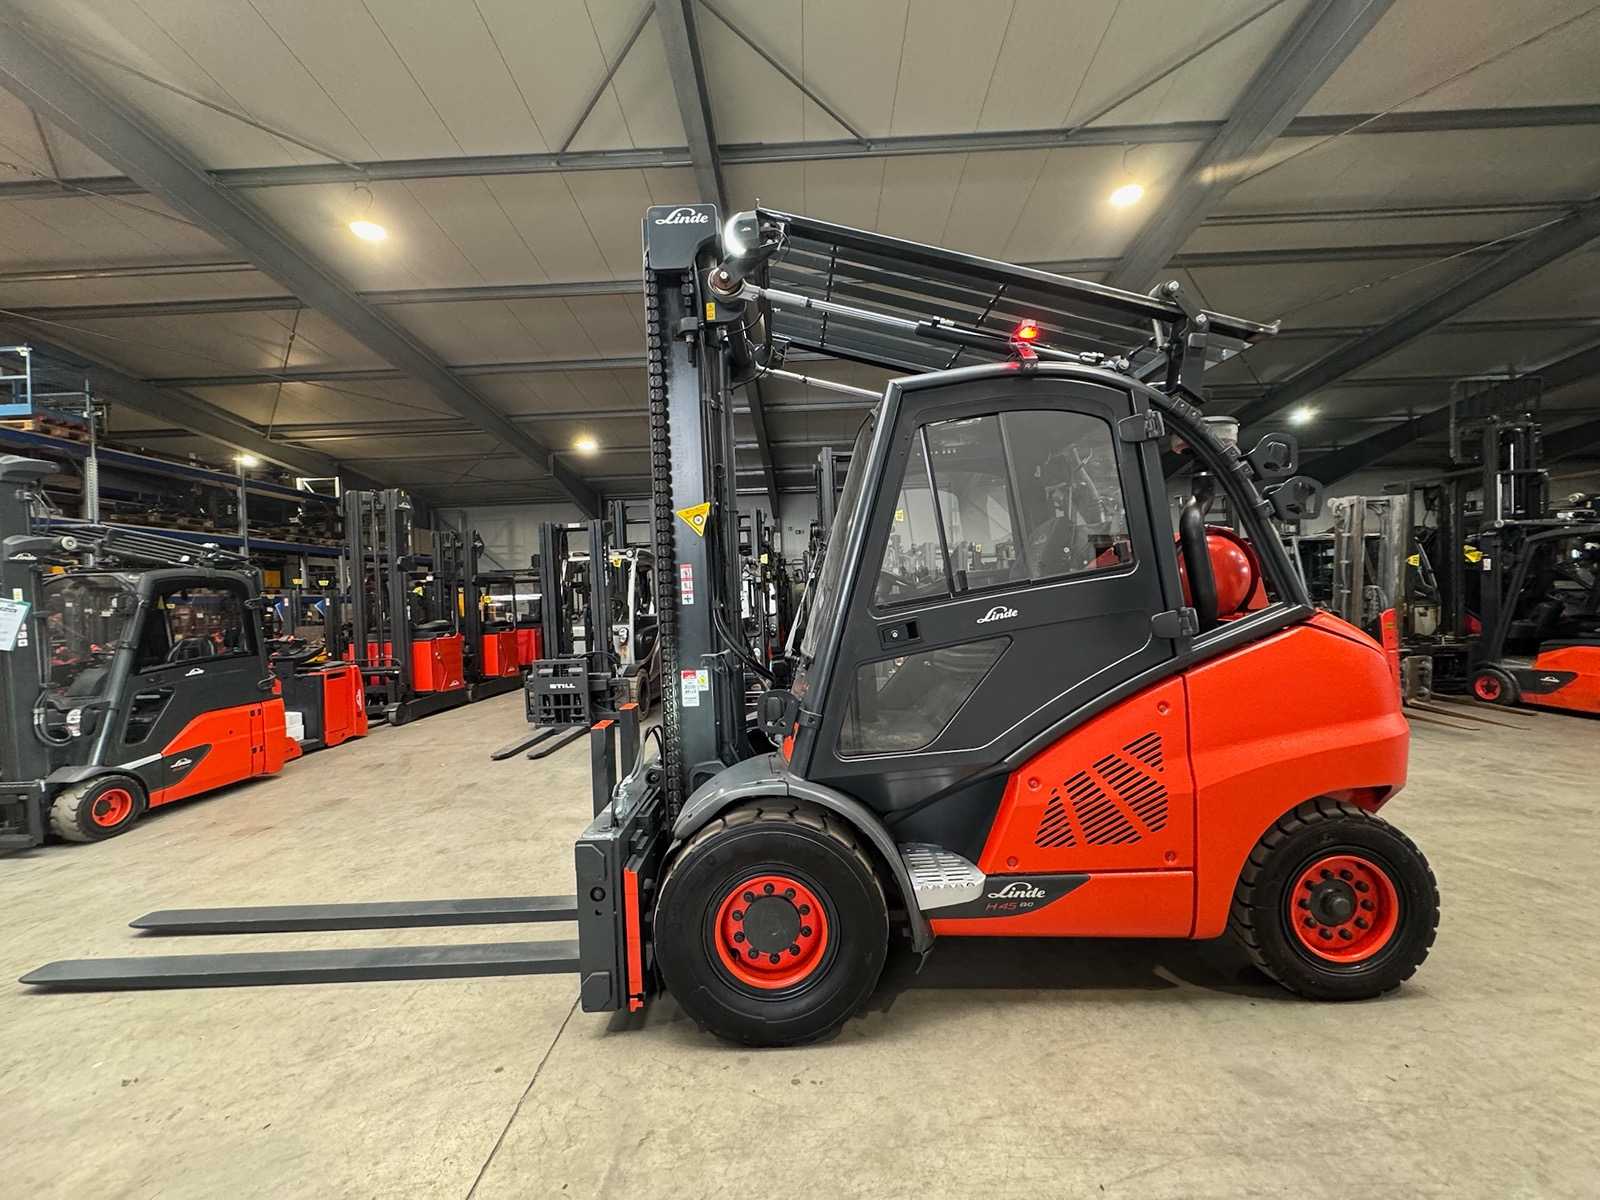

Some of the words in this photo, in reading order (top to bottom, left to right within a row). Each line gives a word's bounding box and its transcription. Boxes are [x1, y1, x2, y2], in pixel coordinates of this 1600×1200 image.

[655, 207, 709, 225] Linde
[976, 605, 1018, 624] Linde
[987, 881, 1047, 899] Linde
